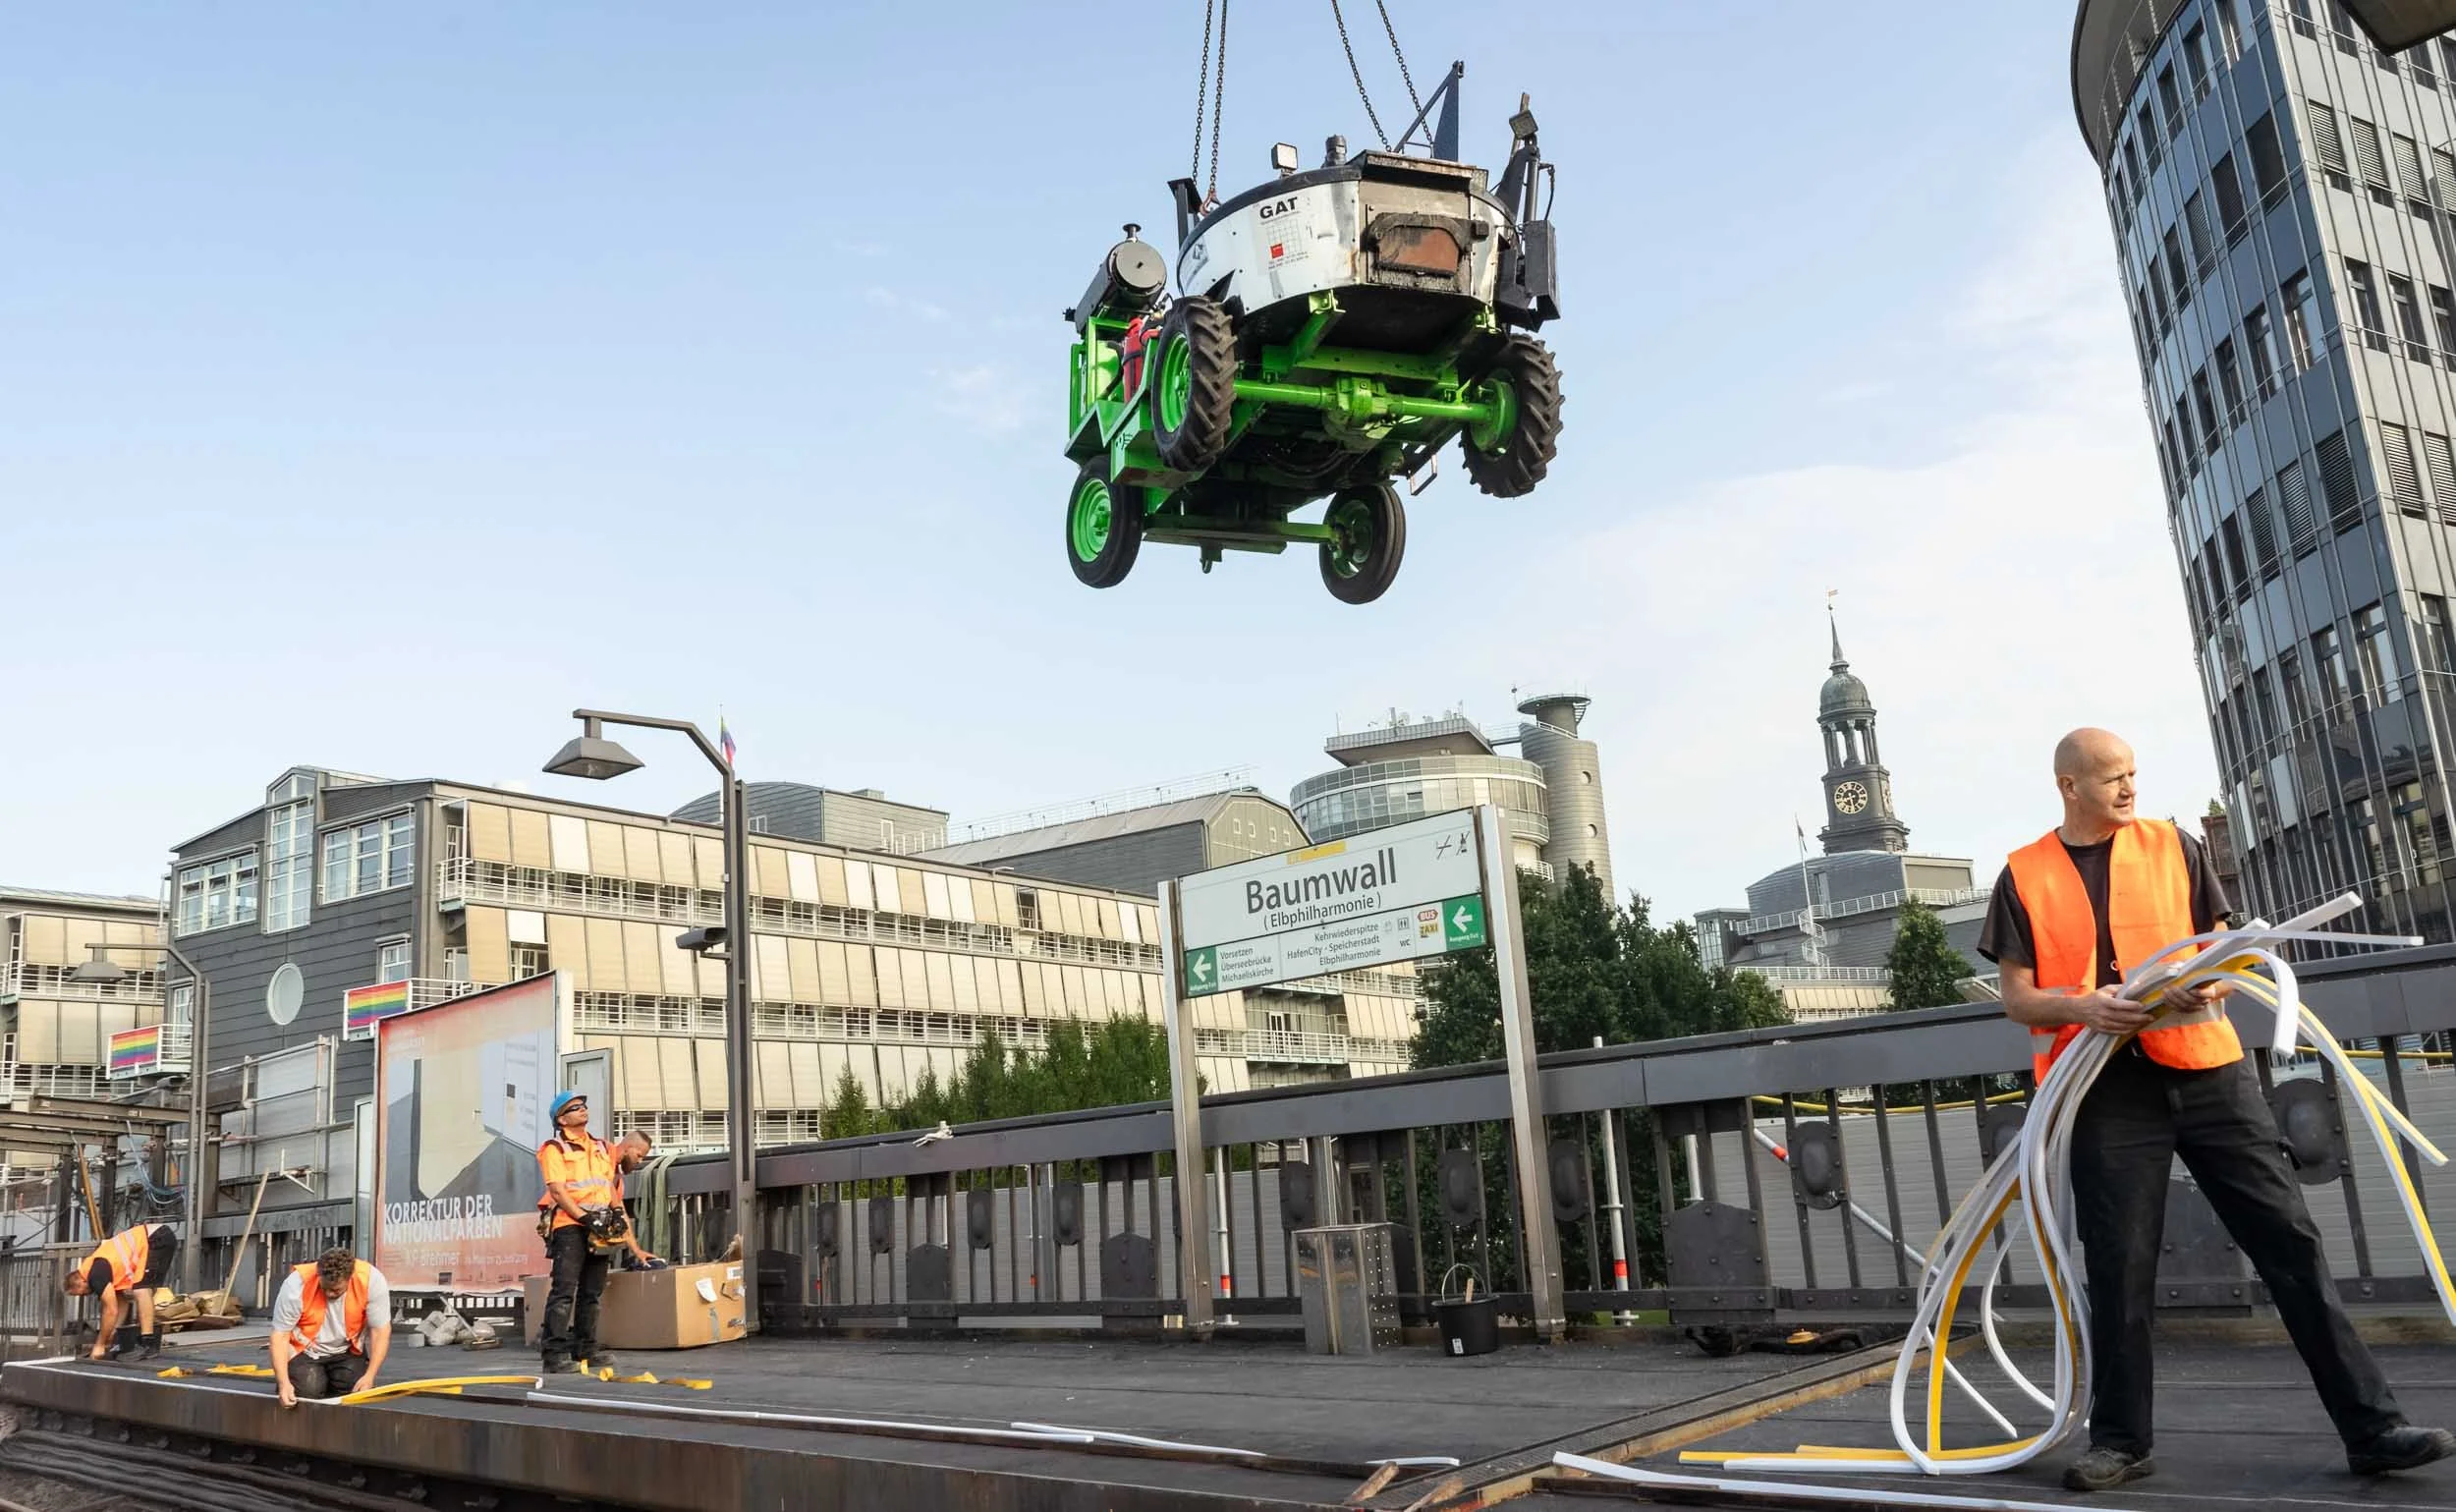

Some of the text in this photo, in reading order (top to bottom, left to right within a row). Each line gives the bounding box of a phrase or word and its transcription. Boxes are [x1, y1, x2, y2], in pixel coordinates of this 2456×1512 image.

[1259, 196, 1298, 219] GAT
[1246, 847, 1397, 915] Baumwall
[1420, 910, 1435, 921] BUS
[1314, 923, 1379, 942] Kehrwiederspitze
[1419, 924, 1439, 935] TAXI
[1220, 946, 1254, 960] Vorsetzen
[1287, 945, 1322, 960] HafenCity
[1328, 934, 1380, 953] Speicherstadt
[1319, 947, 1381, 966] Elbphilharmonie
[1222, 968, 1274, 982] Michaeliskirche
[384, 1194, 493, 1225] KORREKTUR DER
[383, 1214, 503, 1245] NATIONALFARBEN
